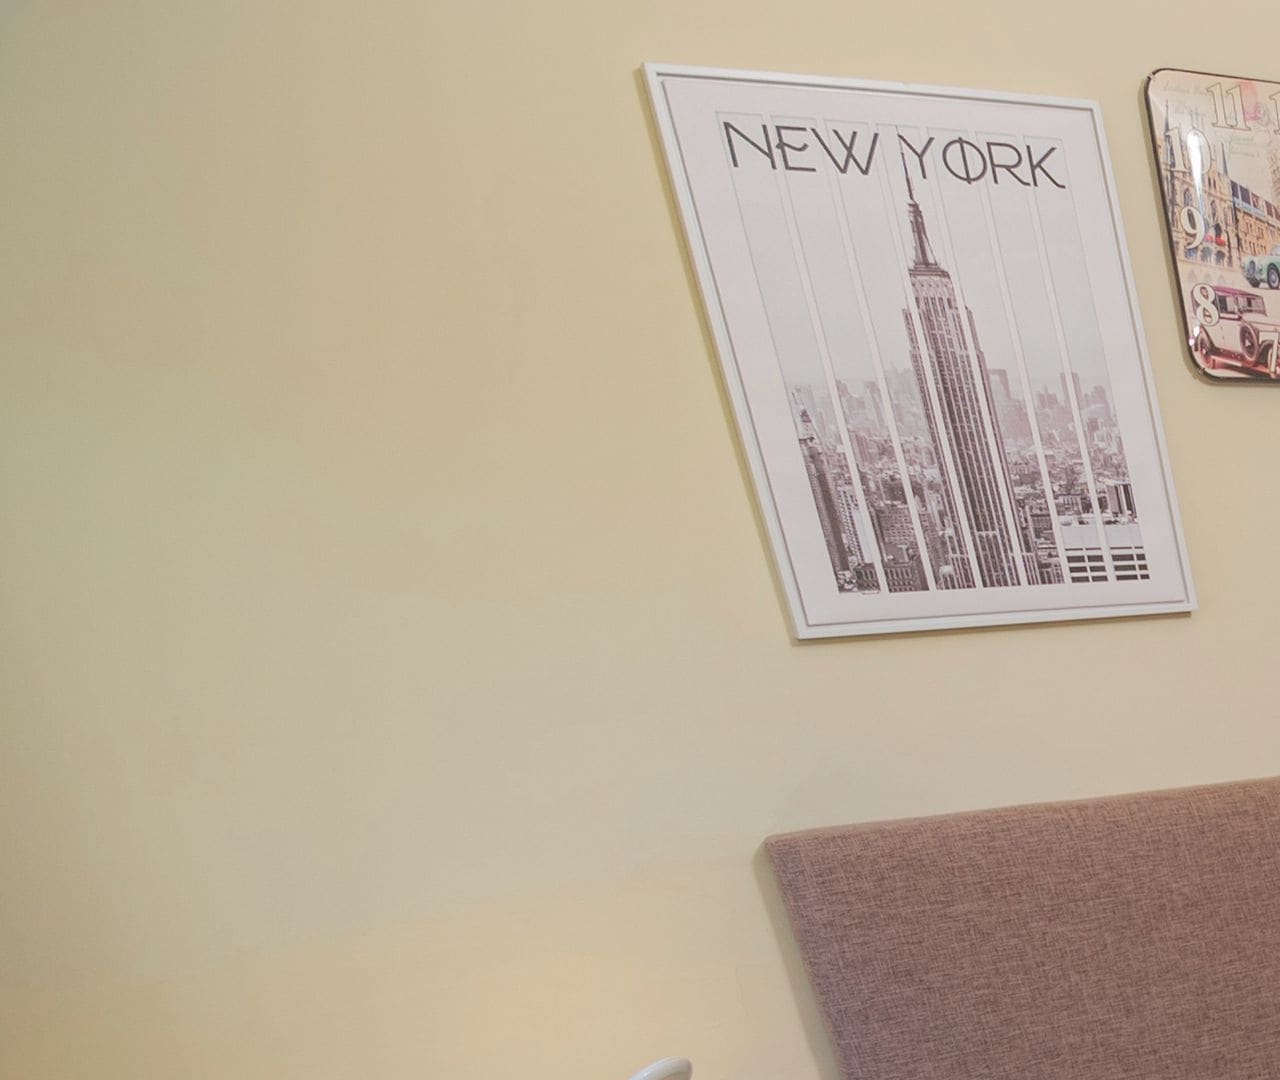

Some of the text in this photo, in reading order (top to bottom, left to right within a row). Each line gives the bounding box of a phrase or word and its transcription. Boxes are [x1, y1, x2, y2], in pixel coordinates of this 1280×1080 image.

[1206, 82, 1252, 131] 11
[723, 121, 1066, 189] NEW YORK
[1179, 206, 1206, 250] 9
[1193, 282, 1220, 327] 8
